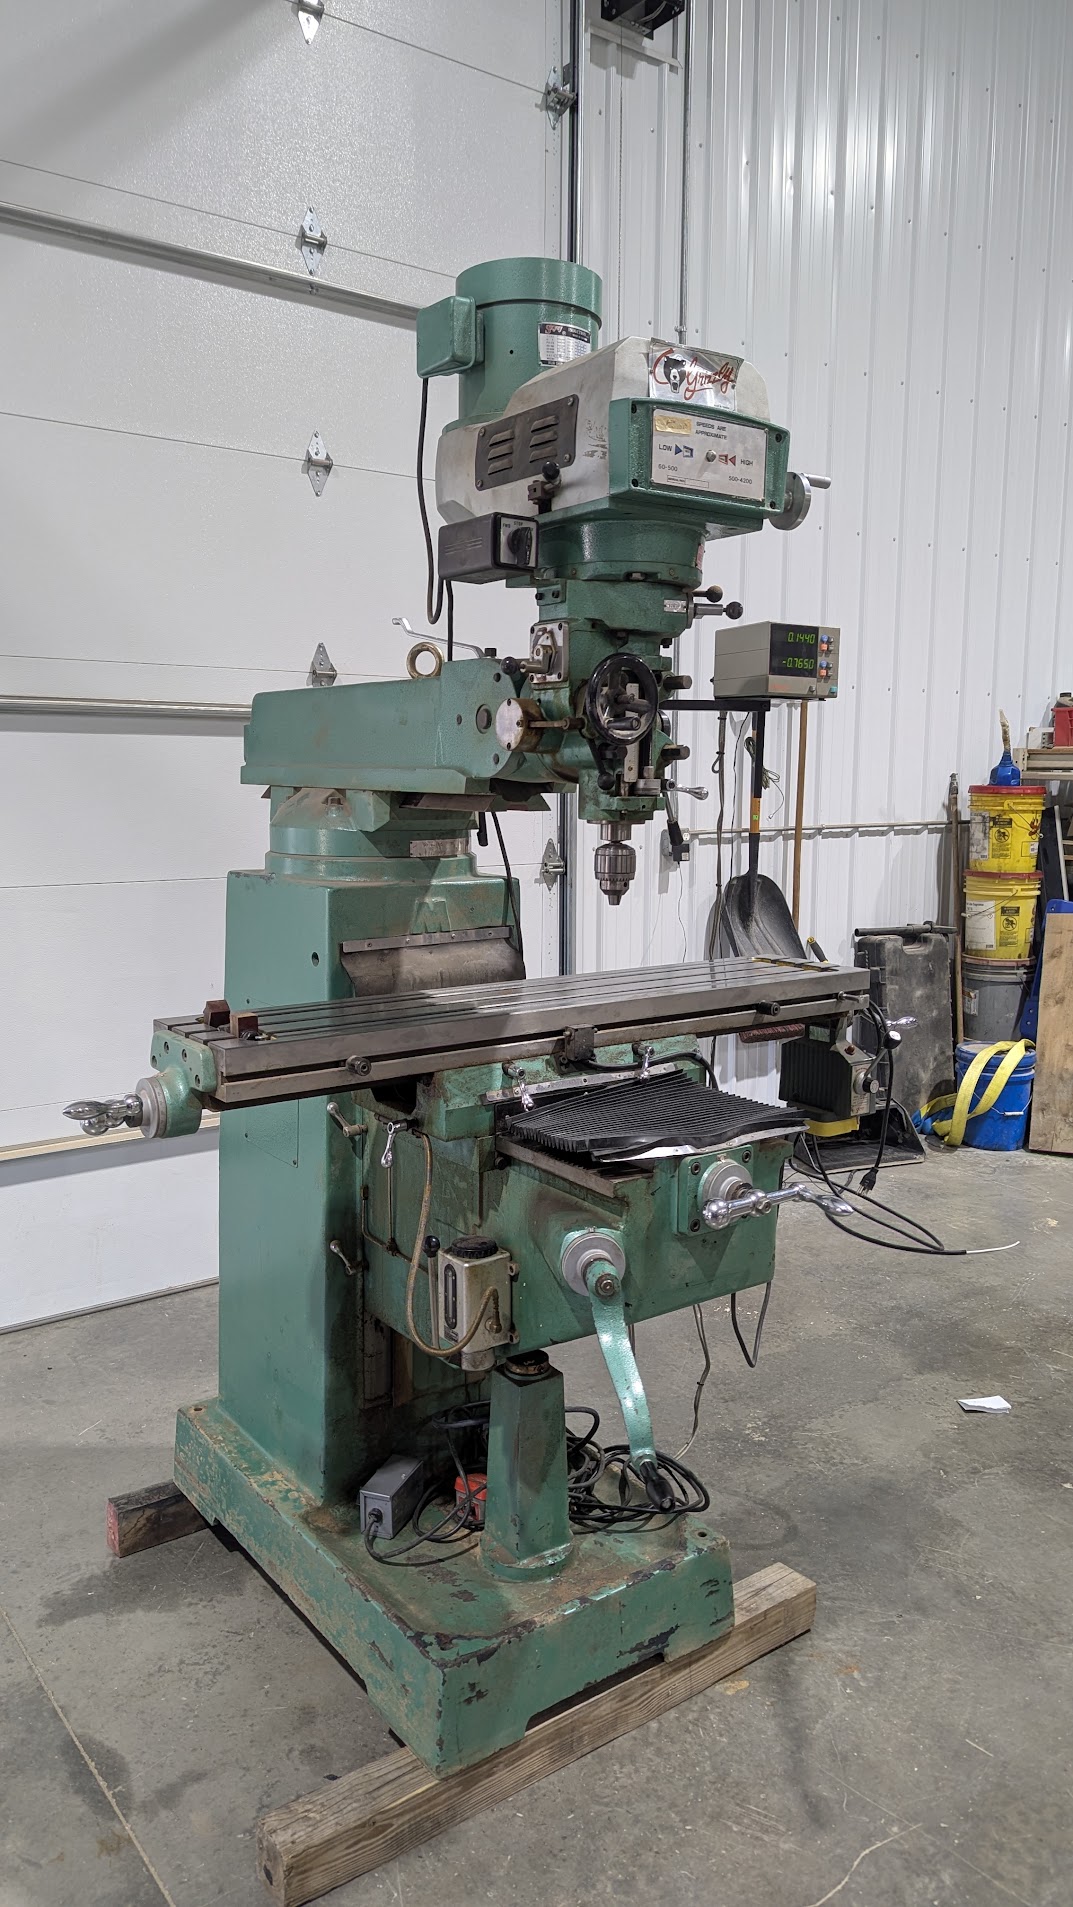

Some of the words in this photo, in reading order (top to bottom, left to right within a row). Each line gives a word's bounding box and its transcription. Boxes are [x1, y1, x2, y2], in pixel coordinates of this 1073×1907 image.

[684, 356, 737, 401] Grizzly
[696, 421, 715, 429] SPEEDS
[695, 429, 728, 440] APPROXIMATE
[658, 443, 673, 452] LOW
[658, 463, 678, 472] 60-500
[740, 458, 754, 467] HIGH
[728, 475, 753, 485] 500-4200
[787, 632, 816, 644] 0.1440
[782, 657, 815, 670] -0.7650
